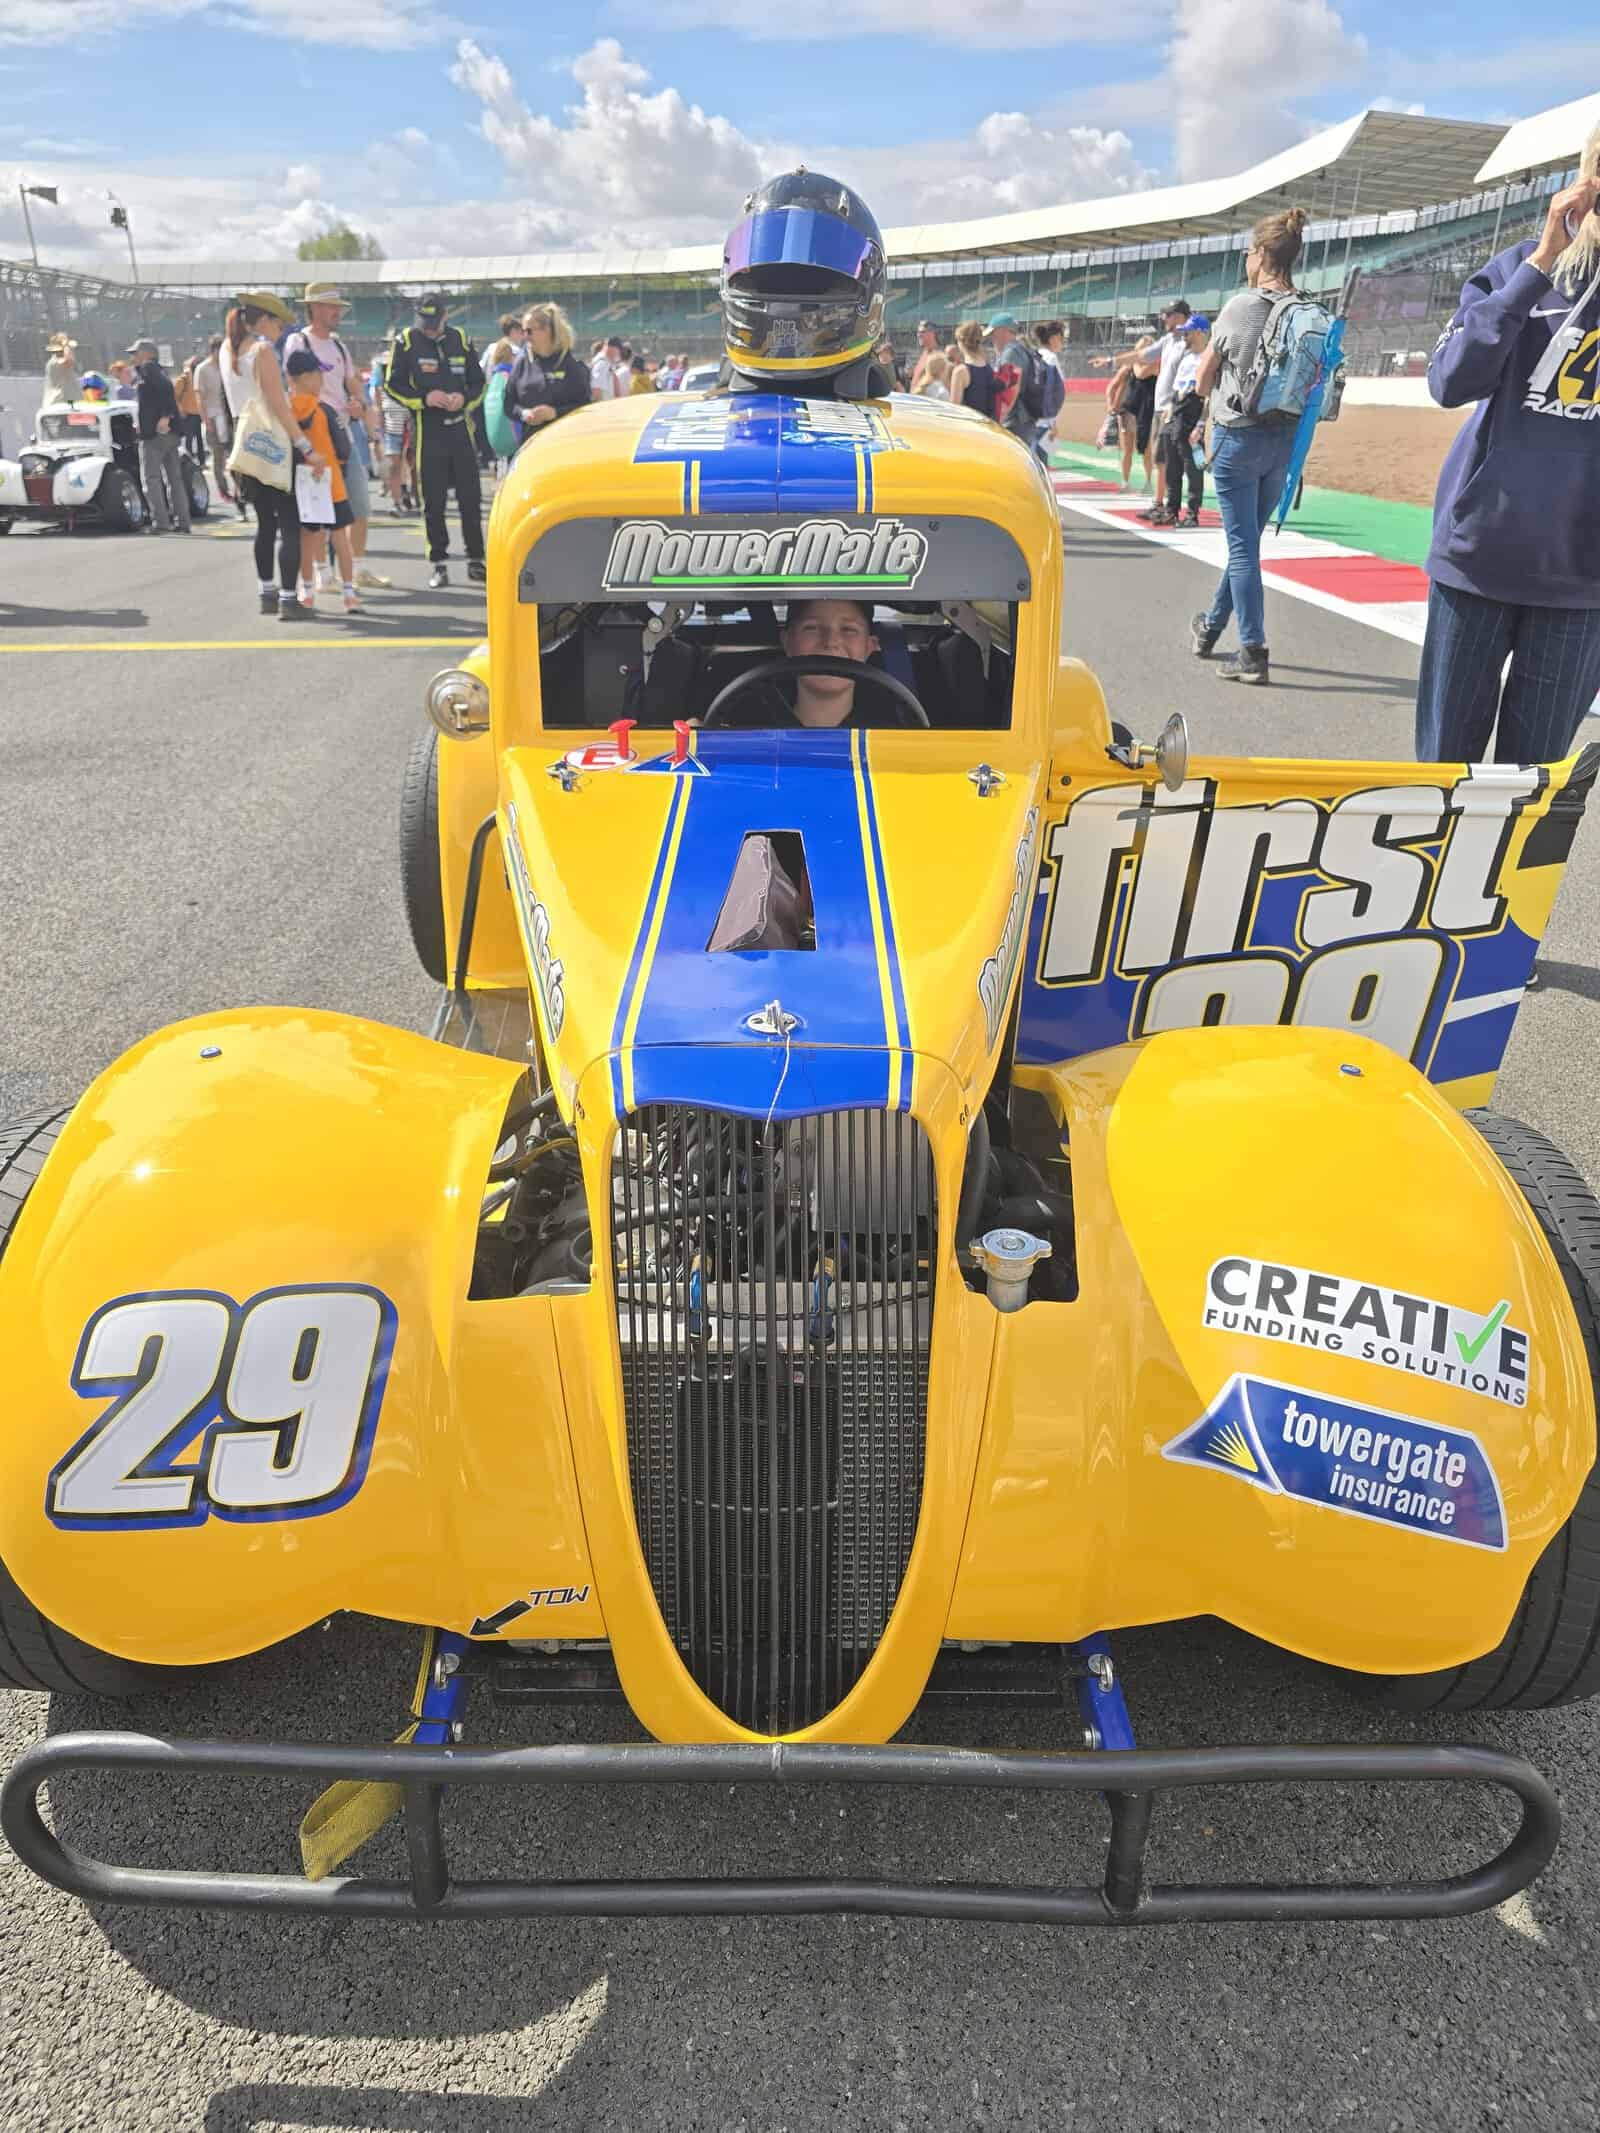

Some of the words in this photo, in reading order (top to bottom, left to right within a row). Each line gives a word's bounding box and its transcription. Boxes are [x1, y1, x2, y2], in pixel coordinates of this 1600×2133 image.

[605, 521, 923, 586] MowerMate
[1040, 763, 1545, 984] first
[1205, 1308, 1343, 1351] FUNDING
[1361, 1341, 1526, 1406] SOLUTIONS
[49, 1287, 390, 1523] 29
[1282, 1399, 1467, 1488] towergate
[1329, 1463, 1456, 1525] insurance
[529, 1585, 590, 1607] TOW
